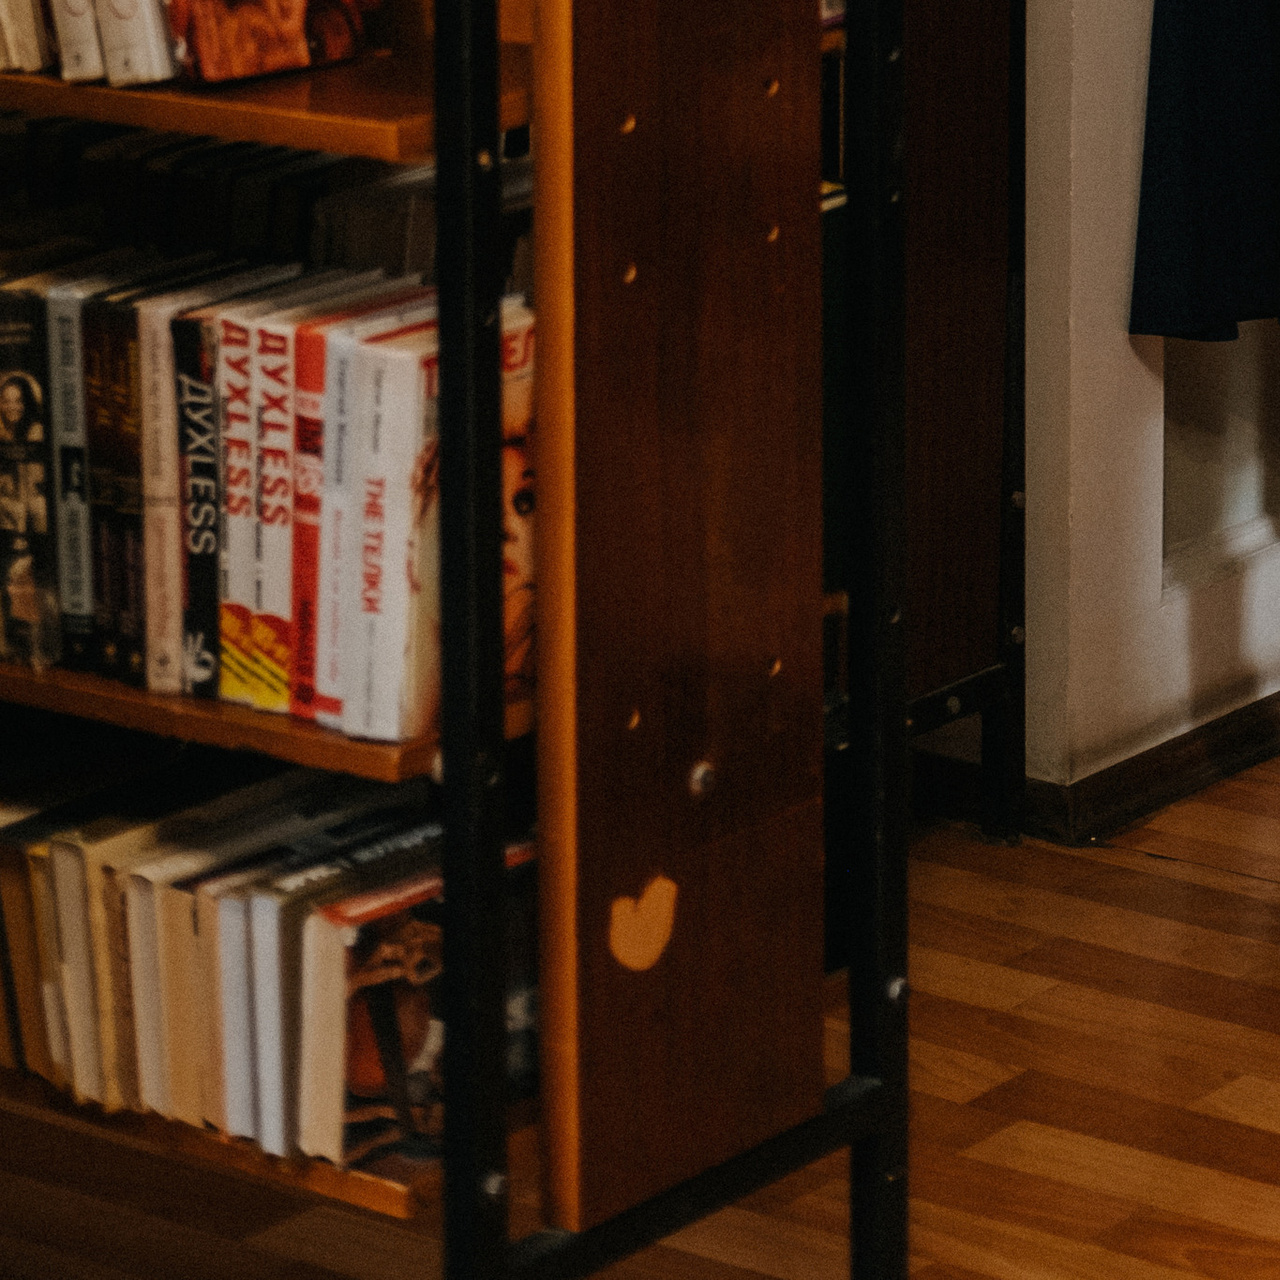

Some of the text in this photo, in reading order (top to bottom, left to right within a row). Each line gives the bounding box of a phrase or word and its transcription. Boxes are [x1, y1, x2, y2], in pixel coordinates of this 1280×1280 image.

[178, 373, 217, 555] ДУХLESS
[221, 320, 252, 518] ДУХLESS
[257, 328, 290, 528] ДУХLESS
[362, 476, 387, 524] THE
[361, 529, 385, 614] ТЕЛКИ
